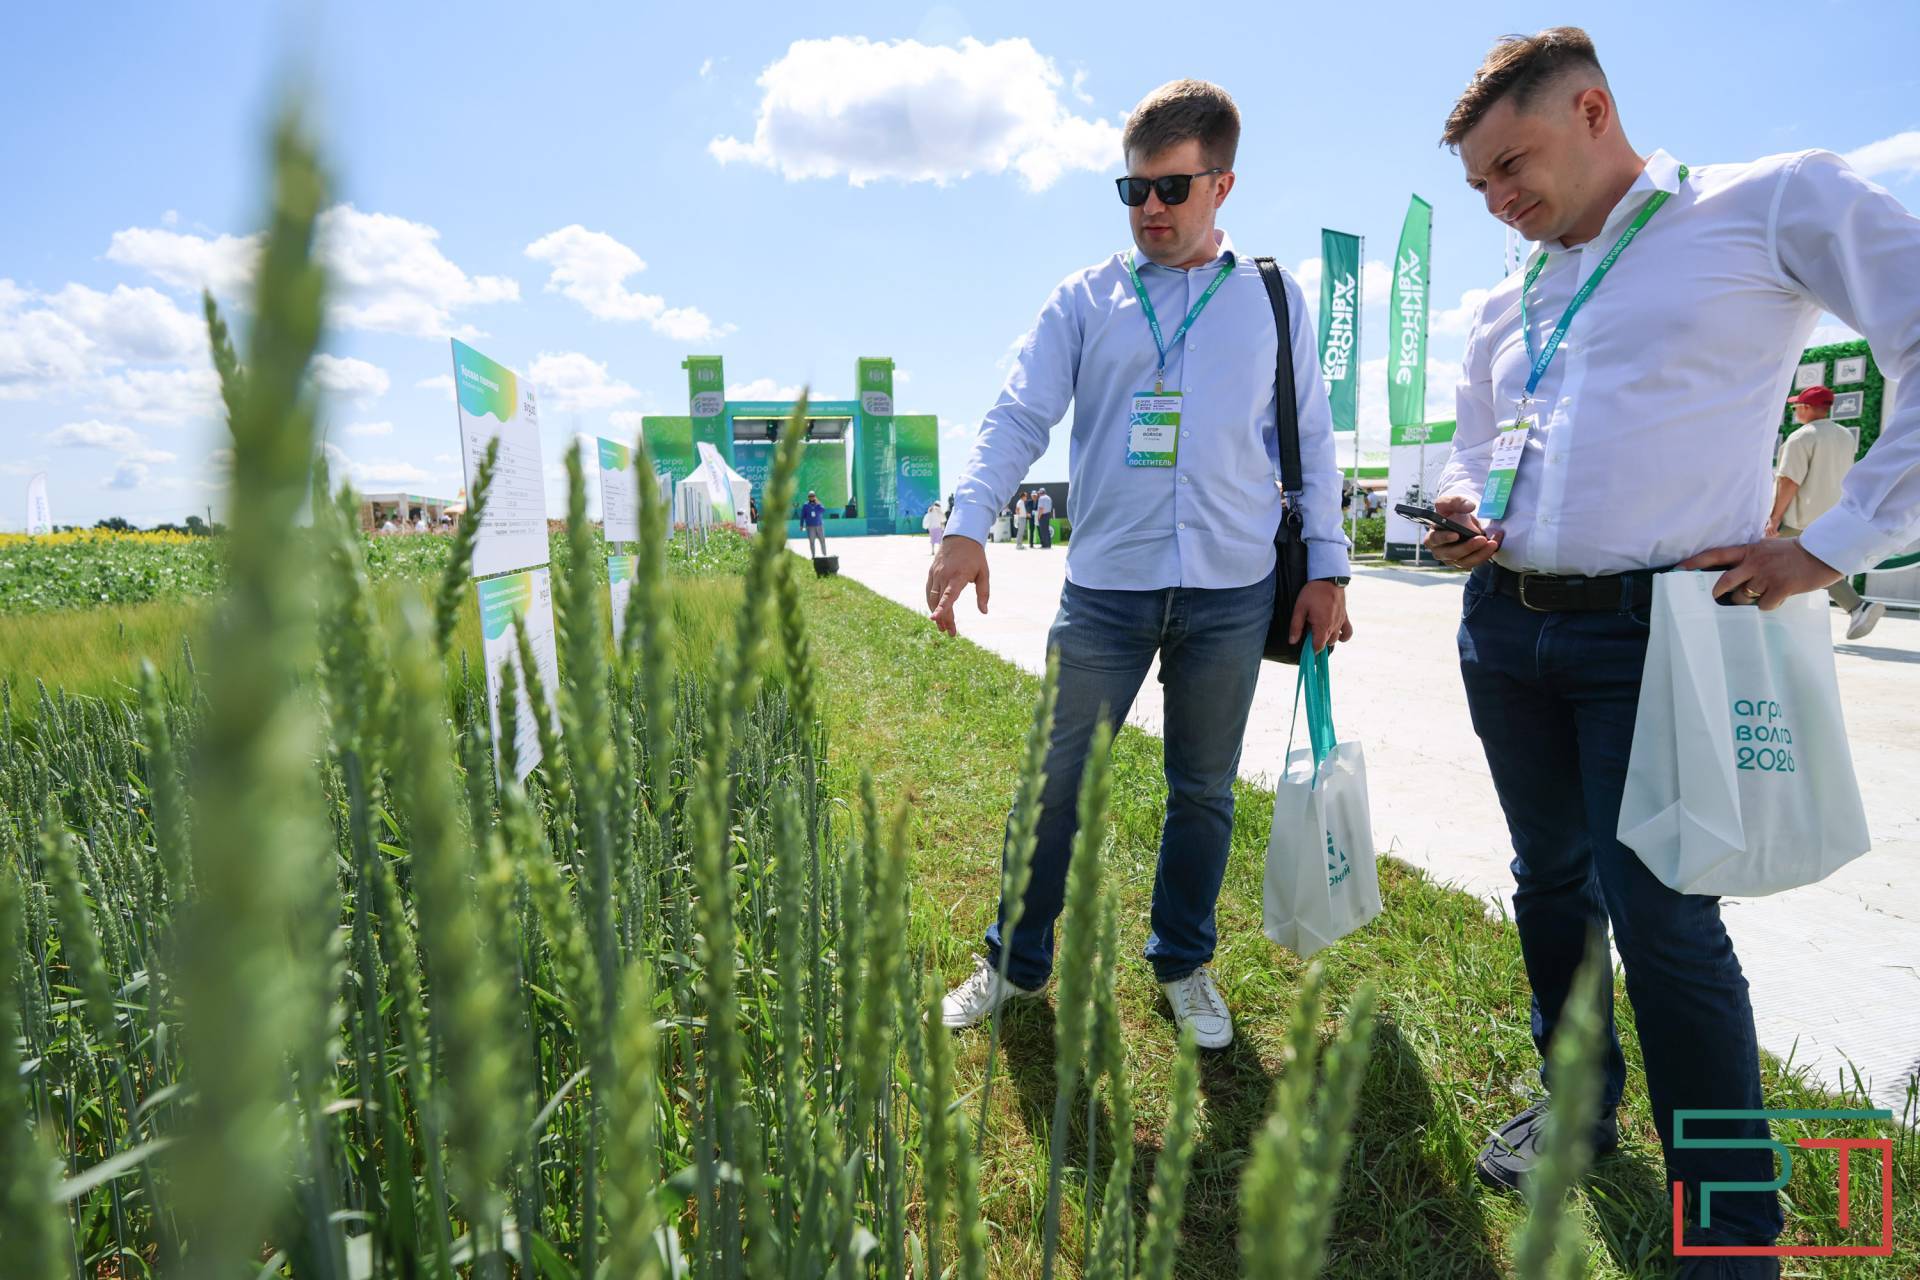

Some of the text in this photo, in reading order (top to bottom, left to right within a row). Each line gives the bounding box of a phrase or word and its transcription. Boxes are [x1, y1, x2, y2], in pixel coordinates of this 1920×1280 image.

[1600, 227, 1638, 270] АГРОВОЛГА
[1536, 329, 1565, 375] АГРОВОЛГА
[1736, 725, 1792, 744] волга
[1737, 747, 1795, 772] 2026
